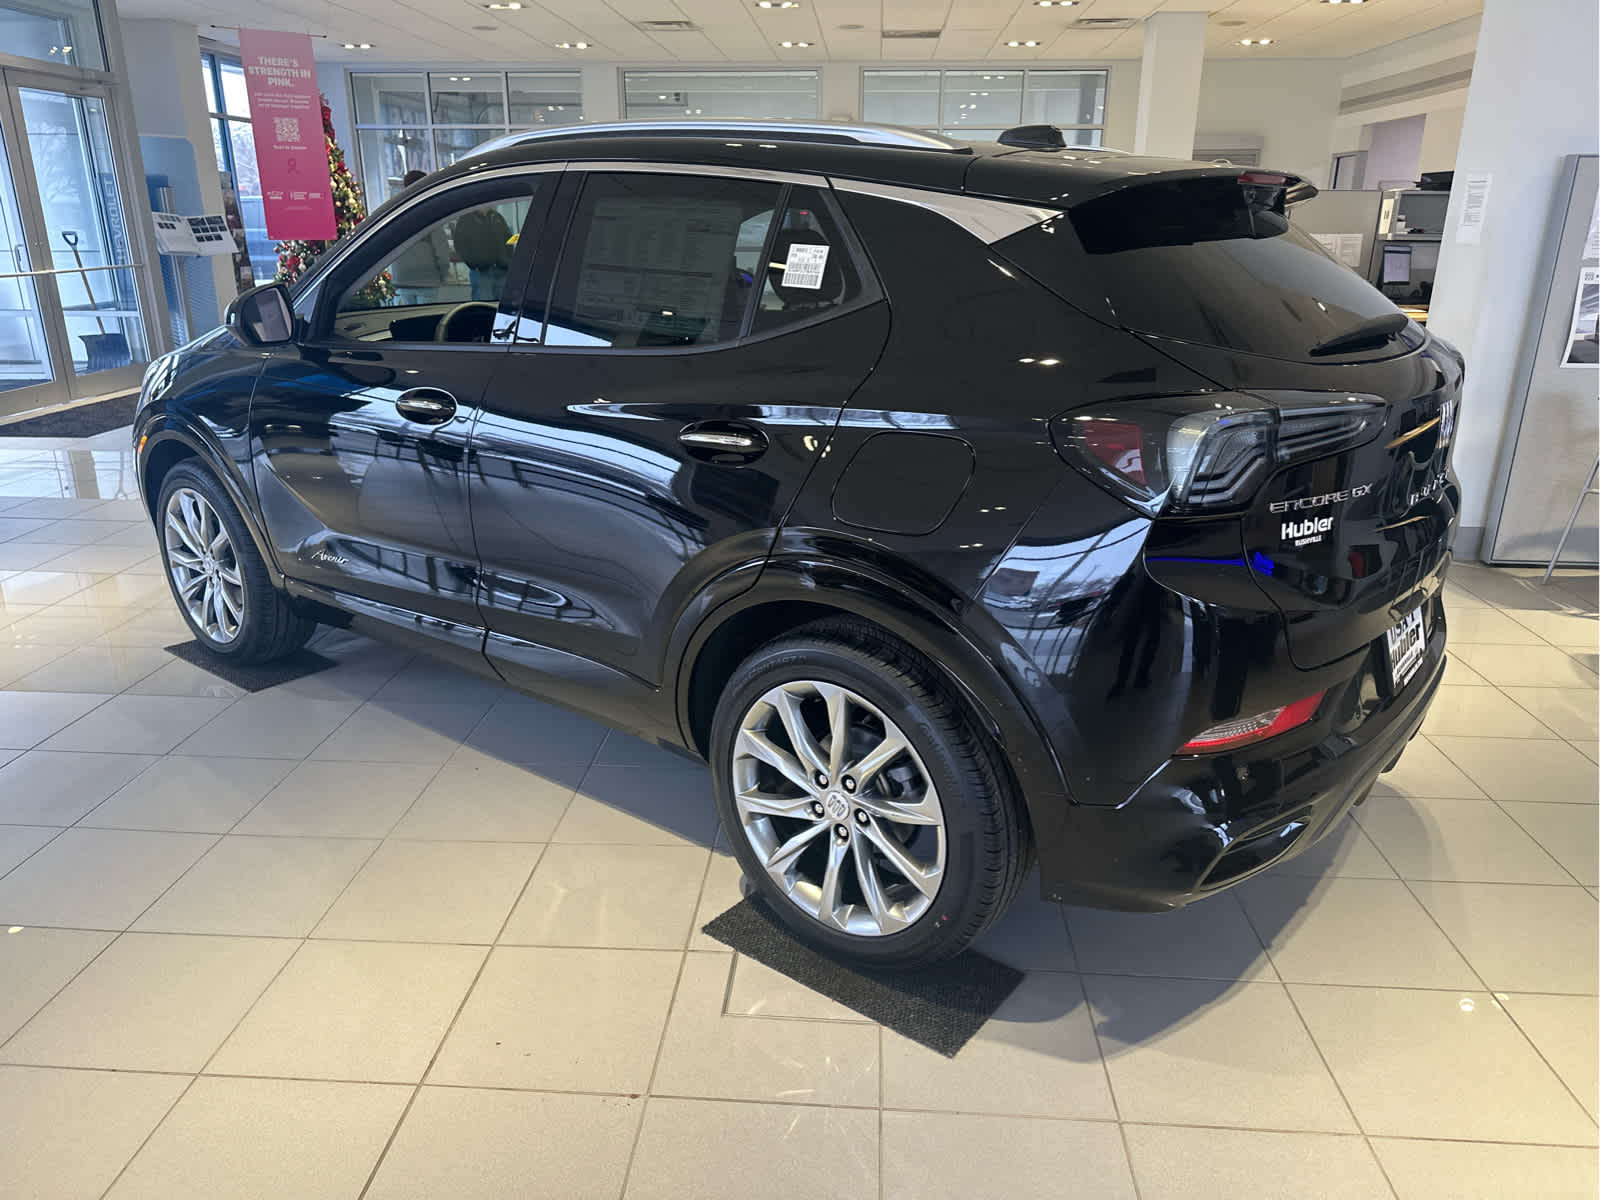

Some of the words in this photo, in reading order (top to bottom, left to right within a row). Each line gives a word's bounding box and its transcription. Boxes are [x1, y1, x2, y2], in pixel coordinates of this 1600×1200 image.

[257, 56, 299, 67] THERE'S
[248, 66, 299, 78] STRENGTH
[300, 69, 311, 79] IN
[268, 77, 295, 88] PINK.
[1269, 490, 1349, 514] ENCORE
[1352, 483, 1373, 498] GX
[1281, 517, 1334, 540] Hubler
[1295, 535, 1322, 546] RUSHVILLE
